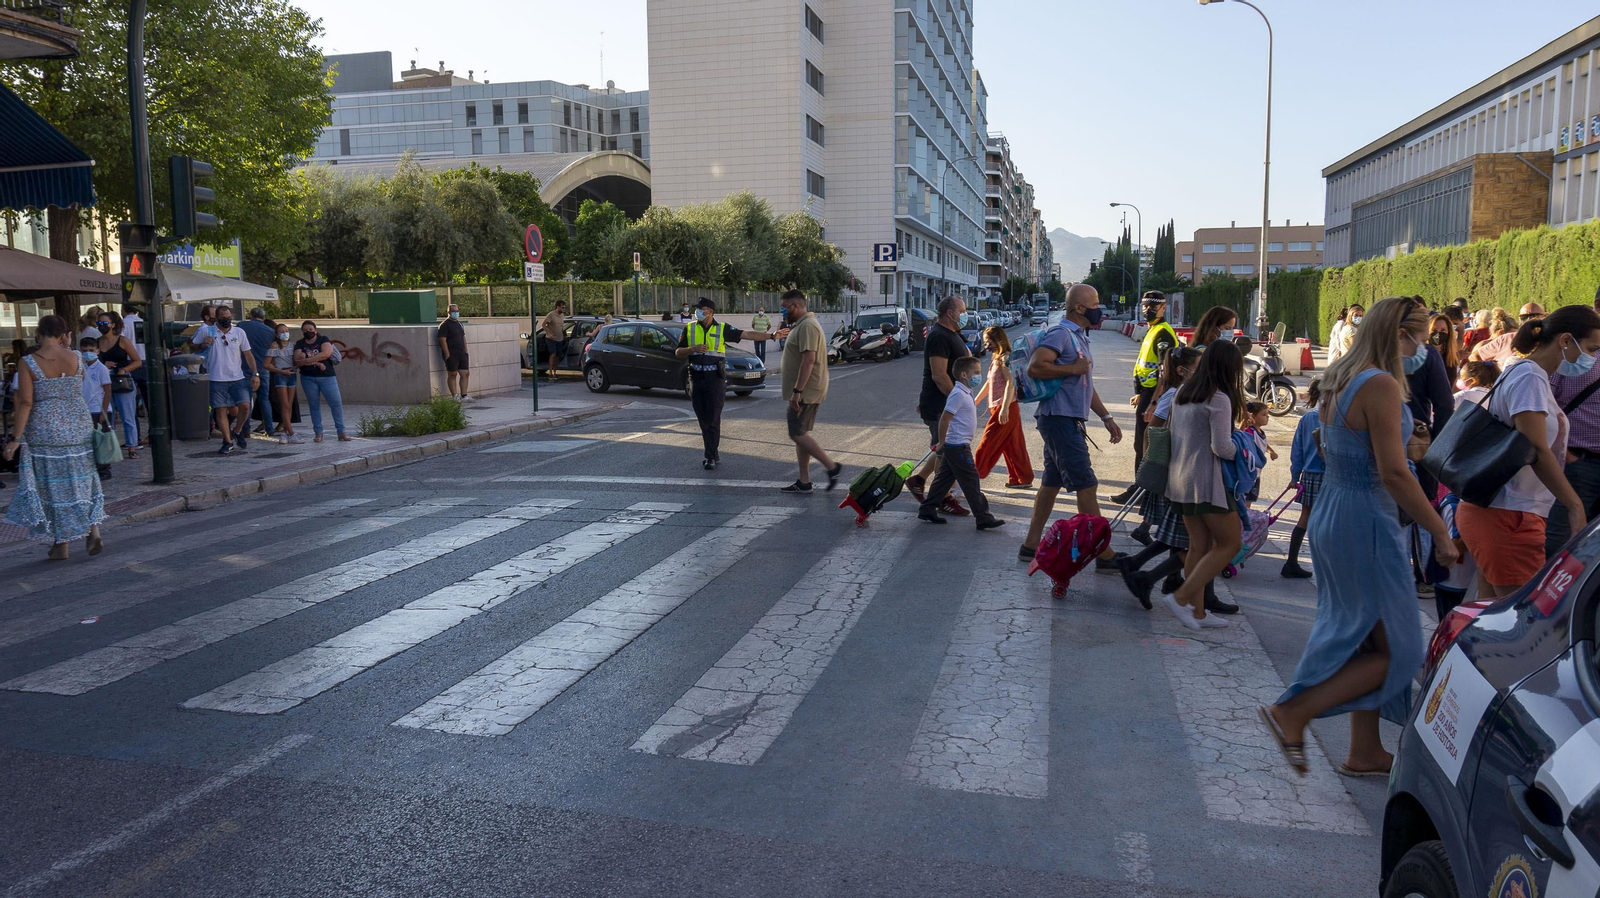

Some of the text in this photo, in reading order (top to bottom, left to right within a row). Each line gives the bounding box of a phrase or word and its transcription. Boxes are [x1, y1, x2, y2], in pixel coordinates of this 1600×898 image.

[159, 251, 234, 268] arking Alsina
[879, 245, 893, 260] P
[80, 279, 108, 289] CERVEZAS
[1551, 569, 1573, 592] 112
[1443, 720, 1457, 739] AÑOS
[1432, 722, 1458, 760] DE HISTORIA
